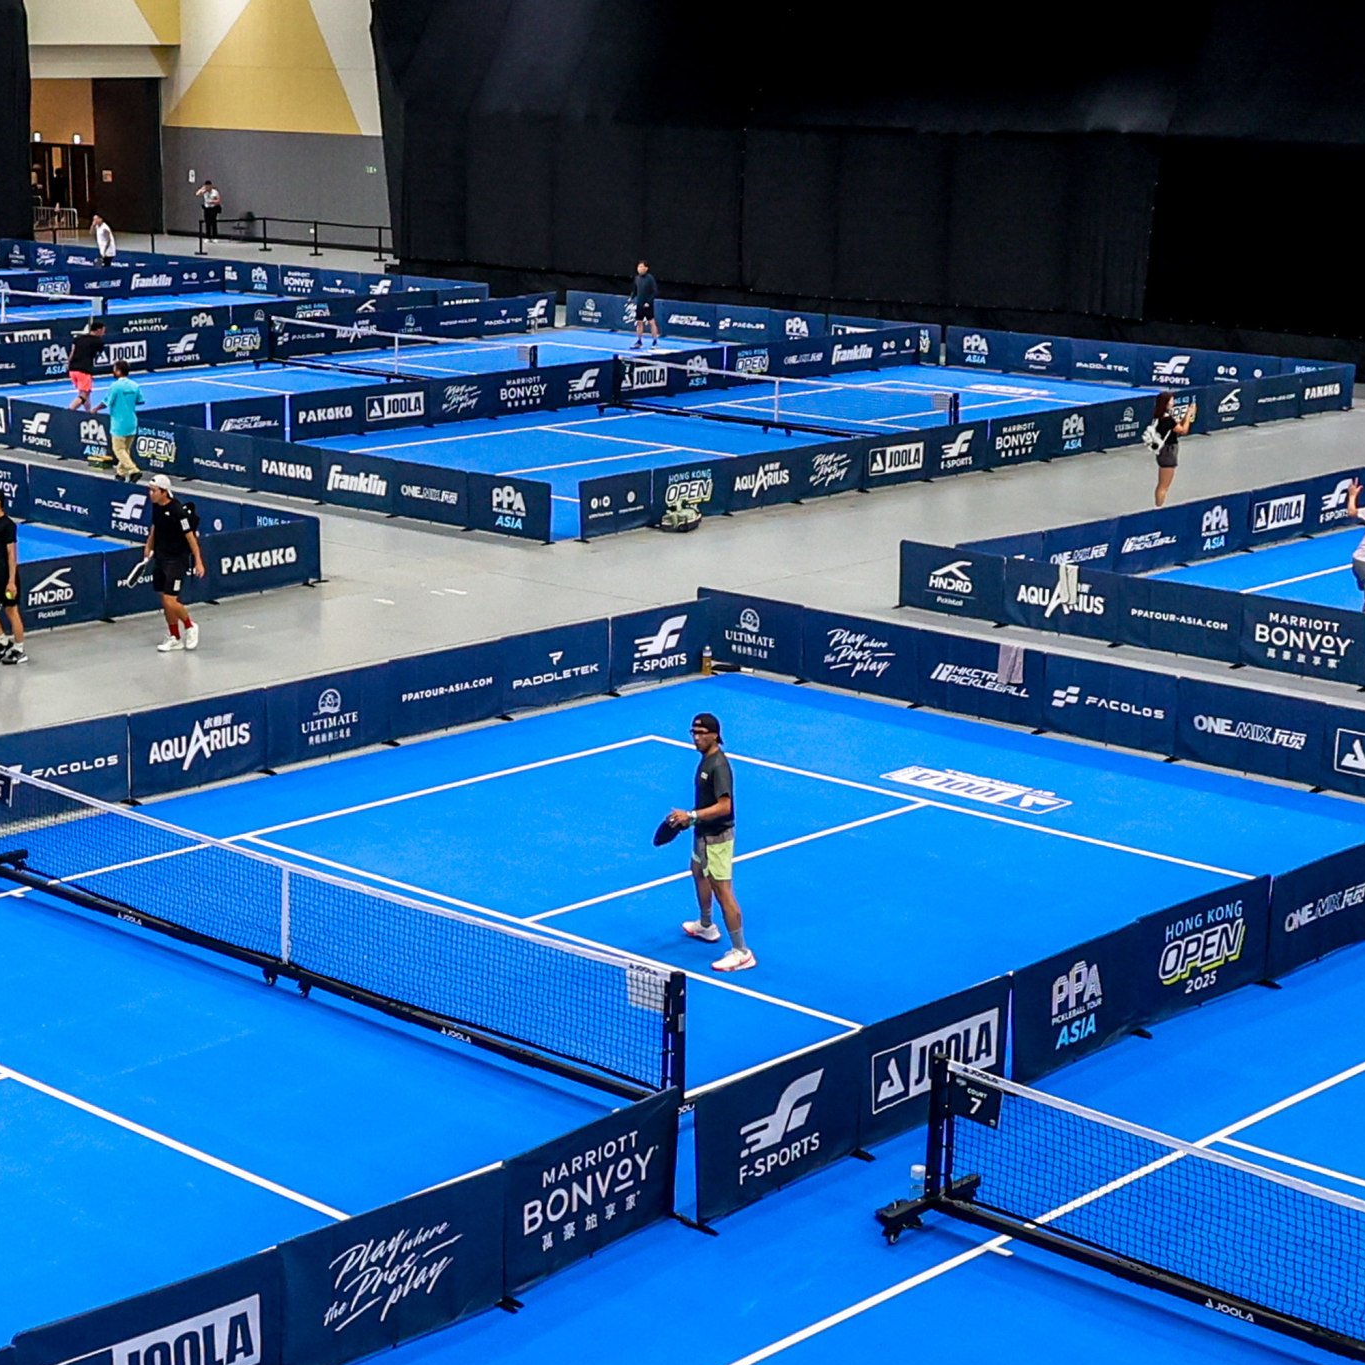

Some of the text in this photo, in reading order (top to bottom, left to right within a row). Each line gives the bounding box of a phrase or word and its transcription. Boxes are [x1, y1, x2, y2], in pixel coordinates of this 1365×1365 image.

[113, 344, 145, 360] JOOLA
[224, 333, 261, 352] OPEN
[963, 335, 988, 355] PPA
[167, 354, 200, 363] F-SPORTS
[966, 355, 986, 364] ASIA
[635, 367, 665, 386] JOOLA
[1152, 374, 1190, 385] F-SPORTS
[386, 396, 422, 416] JOOLA
[568, 391, 600, 402] F-SPORTS
[298, 406, 353, 424] PAKOKO
[1062, 414, 1085, 437] PPA
[22, 434, 51, 448] F-SPORTS
[80, 420, 107, 440] PPA
[83, 445, 105, 456] ASIA
[136, 437, 176, 461] OPEN
[1063, 439, 1083, 451] ASIA
[193, 458, 247, 472] PADDLETEK
[888, 446, 921, 469] JOOLA
[940, 456, 973, 469] F-SPORTS
[261, 460, 313, 480] PAKOKO
[669, 469, 711, 484] HONG KONG
[665, 479, 713, 505] OPEN
[735, 466, 789, 498] AQUARIUS
[35, 498, 88, 515] PADDLETEK
[491, 486, 525, 512] PPA
[1201, 505, 1229, 532] PPA
[1271, 499, 1301, 522] JOOLA
[495, 516, 523, 530] ASIA
[1203, 535, 1225, 551] ASIA
[220, 546, 297, 575] PAKOKO
[1131, 608, 1228, 630] PPATOUR-ASIA.COM
[1269, 612, 1340, 633] MARRIOTT
[725, 630, 775, 649] ULTIMATE
[826, 628, 870, 650] Play
[1255, 623, 1351, 656] BONVOY
[633, 653, 687, 674] F-SPORTS
[512, 662, 599, 689] PADDLETEK
[401, 676, 493, 702] PPATOUR-ASIA.COM
[1085, 695, 1165, 719] FACOLOS
[301, 711, 359, 734] ULTIMATE
[149, 720, 251, 771] AQUARIUS
[31, 755, 118, 778] FACOLOS
[1165, 900, 1243, 943] HONG KONG
[1158, 918, 1245, 986] OPEN
[1051, 960, 1103, 1017] PPA
[1185, 970, 1217, 995] 2025
[1051, 1008, 1086, 1026] PICKLEBALL
[1055, 1014, 1097, 1051] ASIA
[969, 1097, 983, 1115] 7
[542, 1130, 640, 1188] MARRIOTT
[739, 1132, 820, 1186] F-SPORTS
[522, 1146, 655, 1237] BONVOY
[328, 1228, 410, 1290] Play
[379, 1256, 454, 1321] play
[1214, 1299, 1255, 1323] JOOLA
